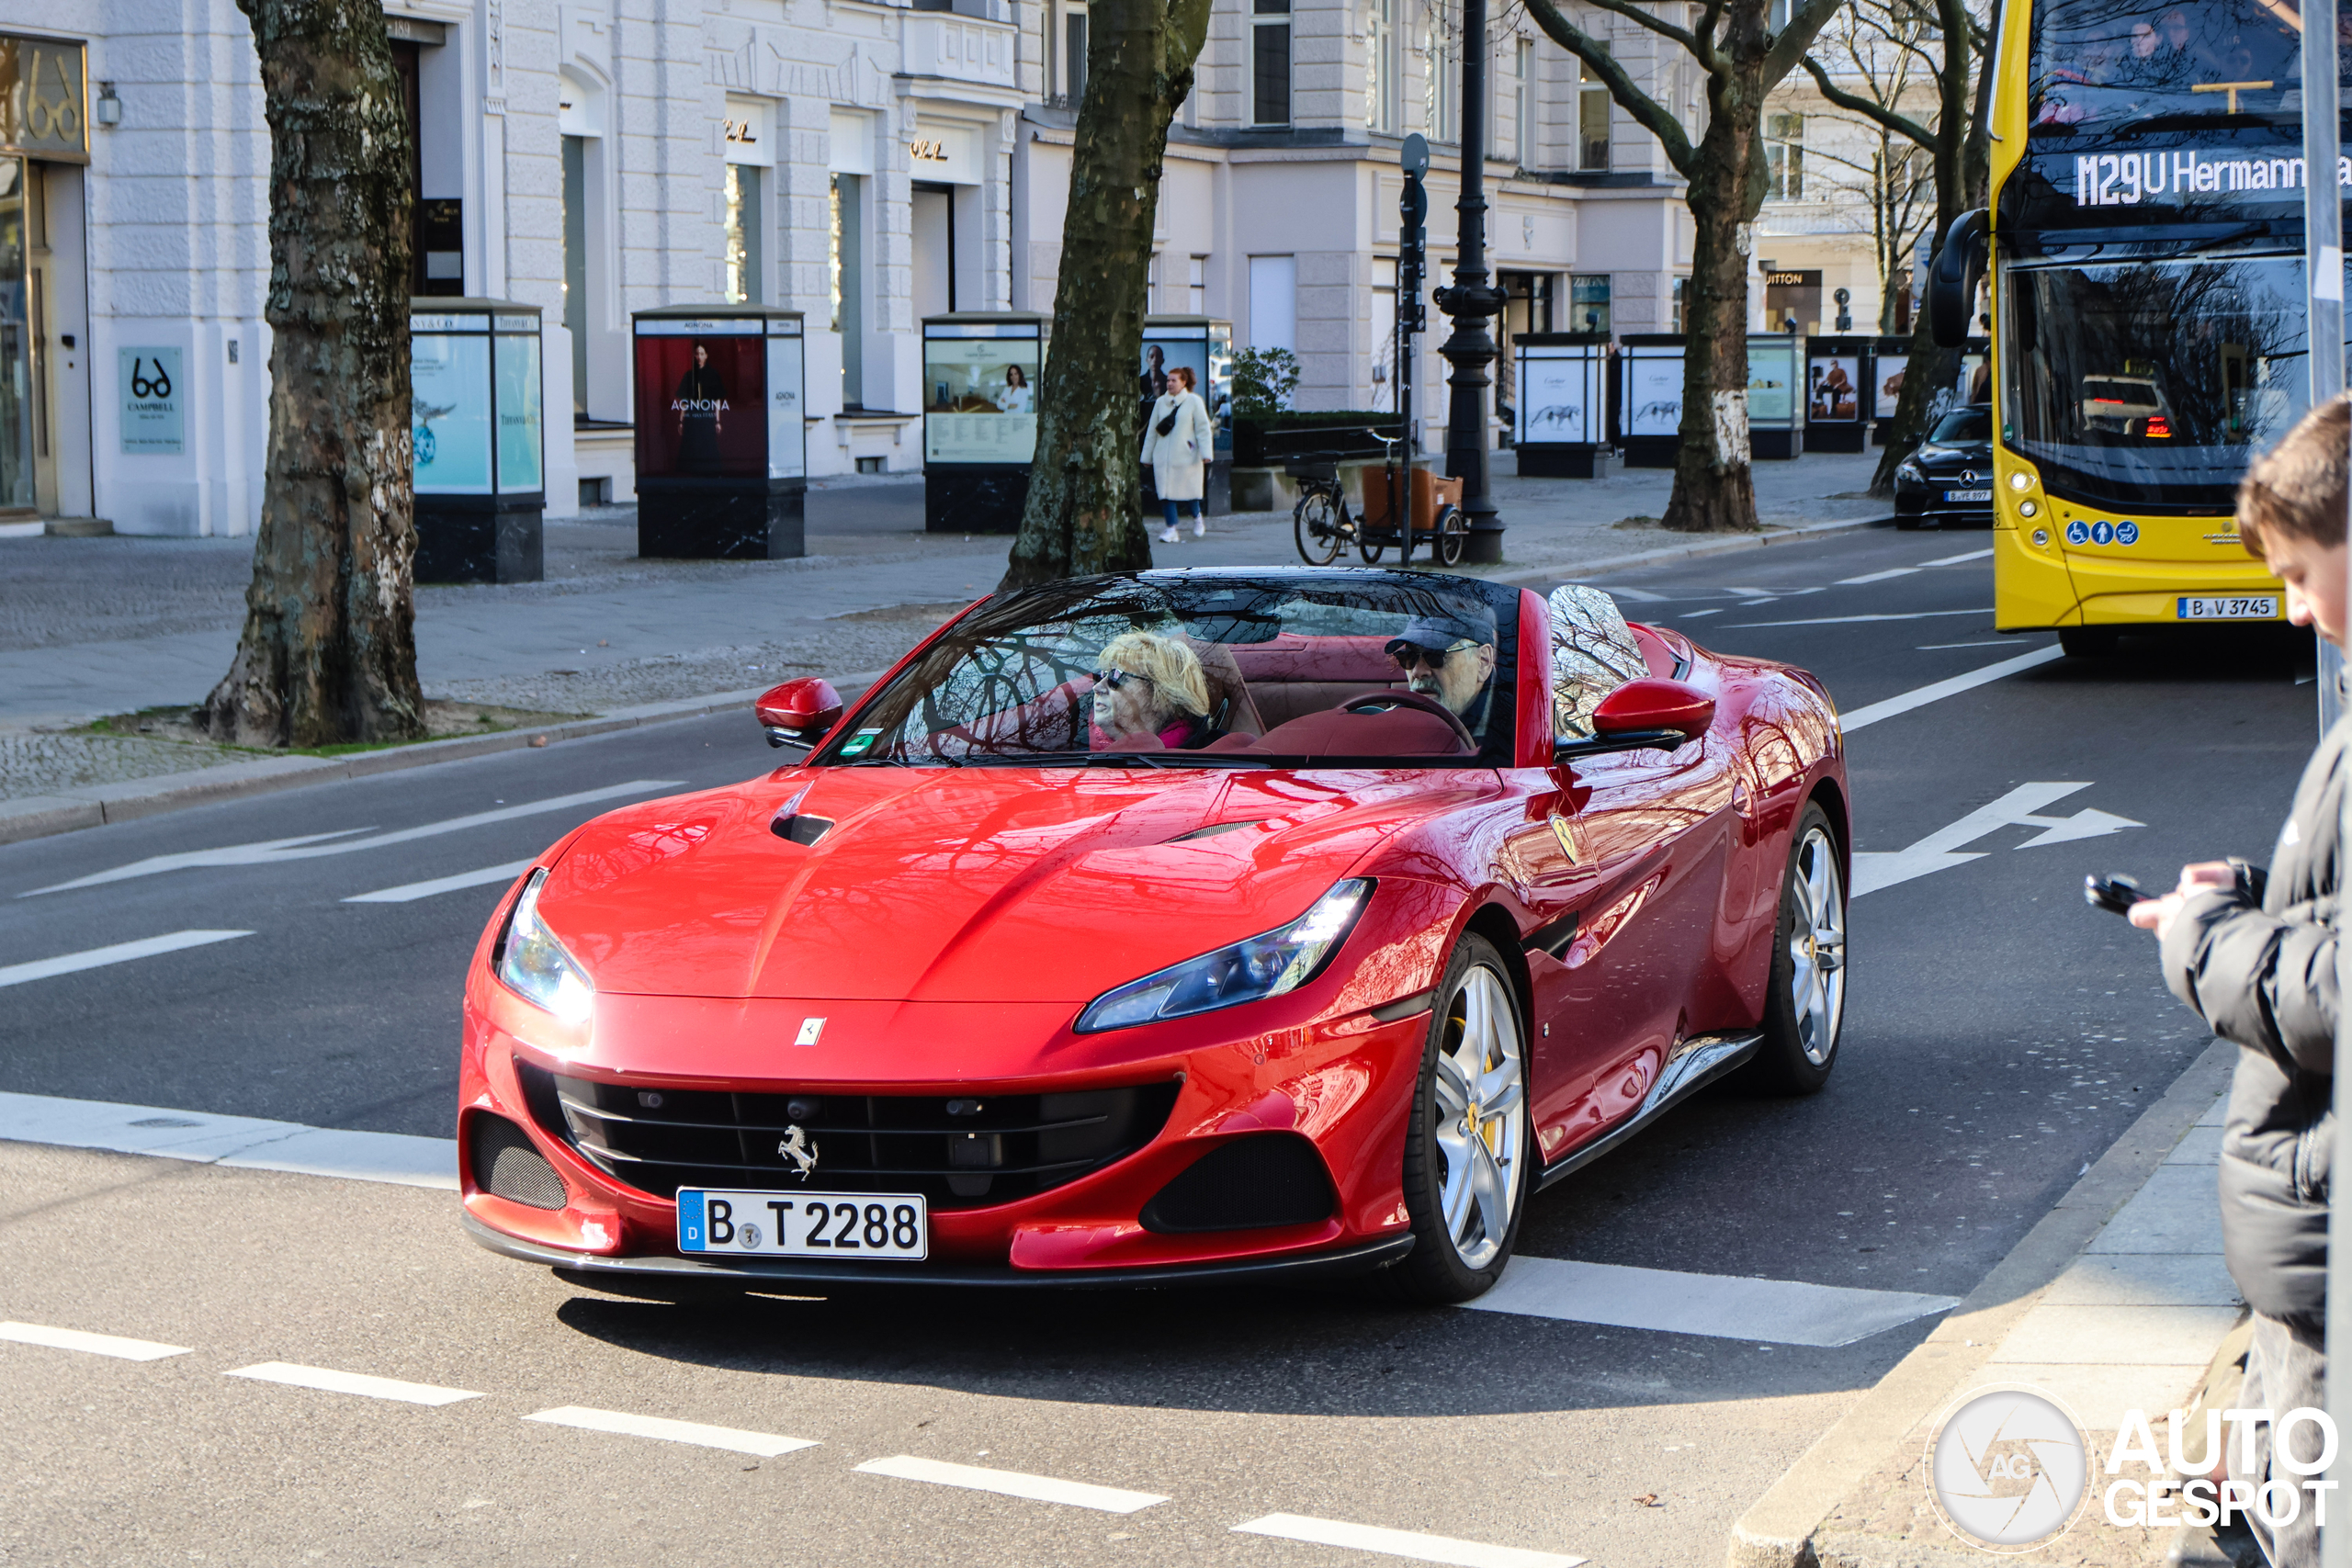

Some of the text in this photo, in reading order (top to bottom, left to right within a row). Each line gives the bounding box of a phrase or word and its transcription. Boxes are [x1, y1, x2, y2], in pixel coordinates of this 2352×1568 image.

[2077, 154, 2142, 206] M29
[2143, 152, 2166, 195] U
[1766, 274, 1803, 285] UITTON
[128, 403, 175, 412] CAMPBELL
[671, 400, 730, 411] AGNONA
[2193, 599, 2269, 615] B V 3745
[688, 1199, 919, 1249] D B T 2288
